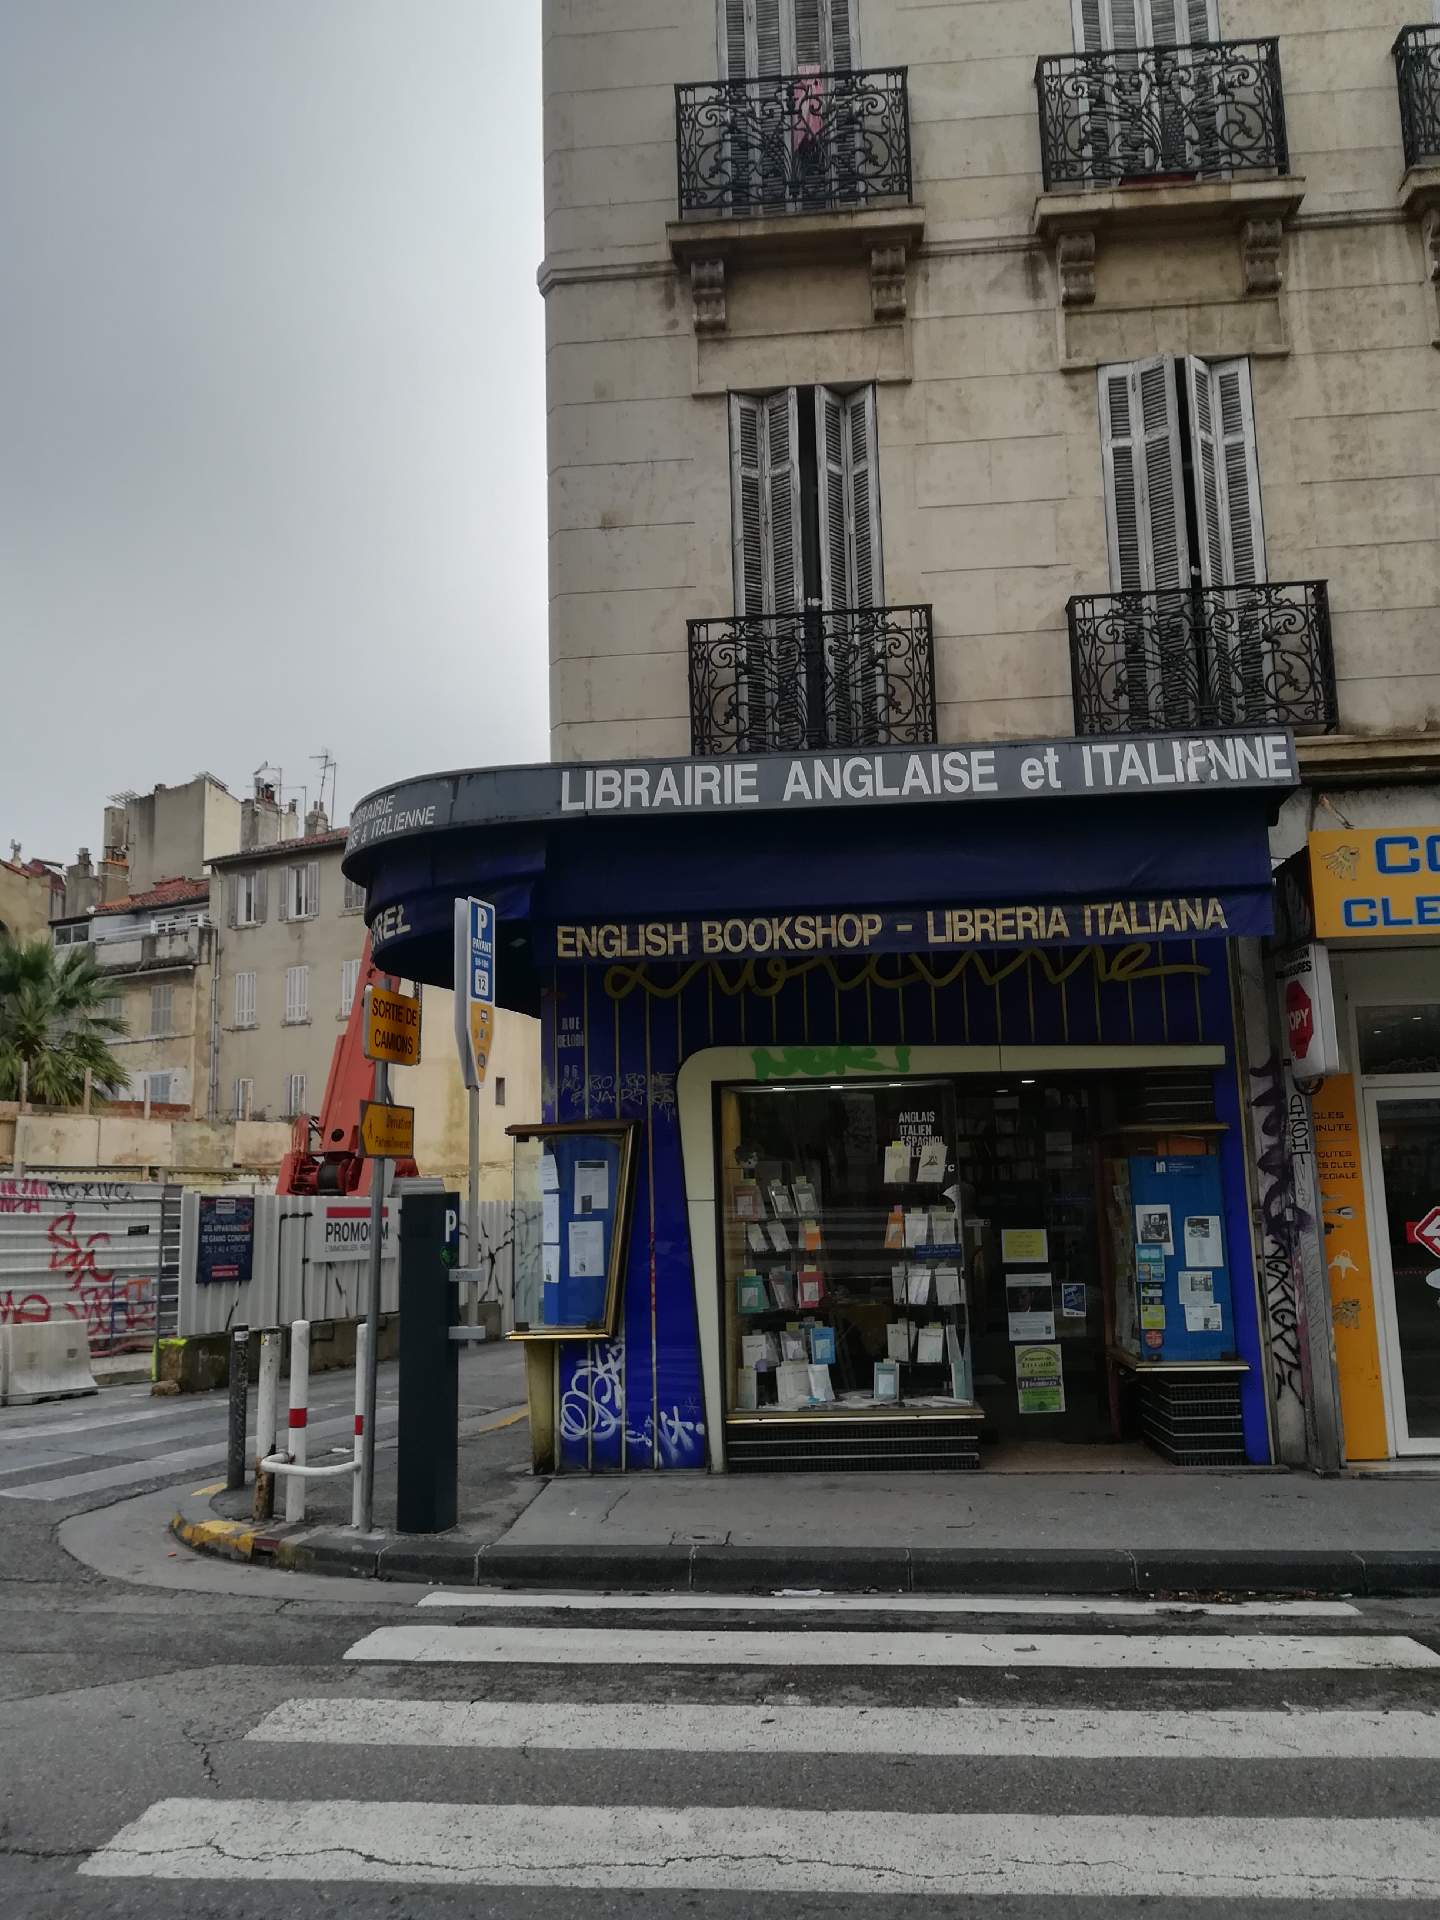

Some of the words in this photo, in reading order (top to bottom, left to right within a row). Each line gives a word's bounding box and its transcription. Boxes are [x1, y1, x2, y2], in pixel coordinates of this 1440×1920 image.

[561, 763, 760, 811] LIBRAIRIE
[782, 750, 998, 801] ANGLAISE
[1020, 747, 1062, 789] et
[1082, 735, 1293, 787] ITALIENNE
[371, 805, 436, 840] ITALIENNE
[477, 907, 488, 939] P
[556, 922, 689, 959] ENGLISH
[701, 913, 883, 954] BOOKSHOP
[926, 906, 1071, 944] LIBRERIA
[1084, 897, 1229, 936] ITALIANA
[472, 937, 492, 953] PAYANT
[478, 978, 486, 991] 12
[372, 997, 403, 1023] SORTIE
[406, 1008, 417, 1027] DE
[374, 1029, 413, 1055] CAMIONS
[899, 1111, 935, 1123] ANGLAIS
[900, 1124, 932, 1136] ITALIEN
[445, 1210, 457, 1243] P
